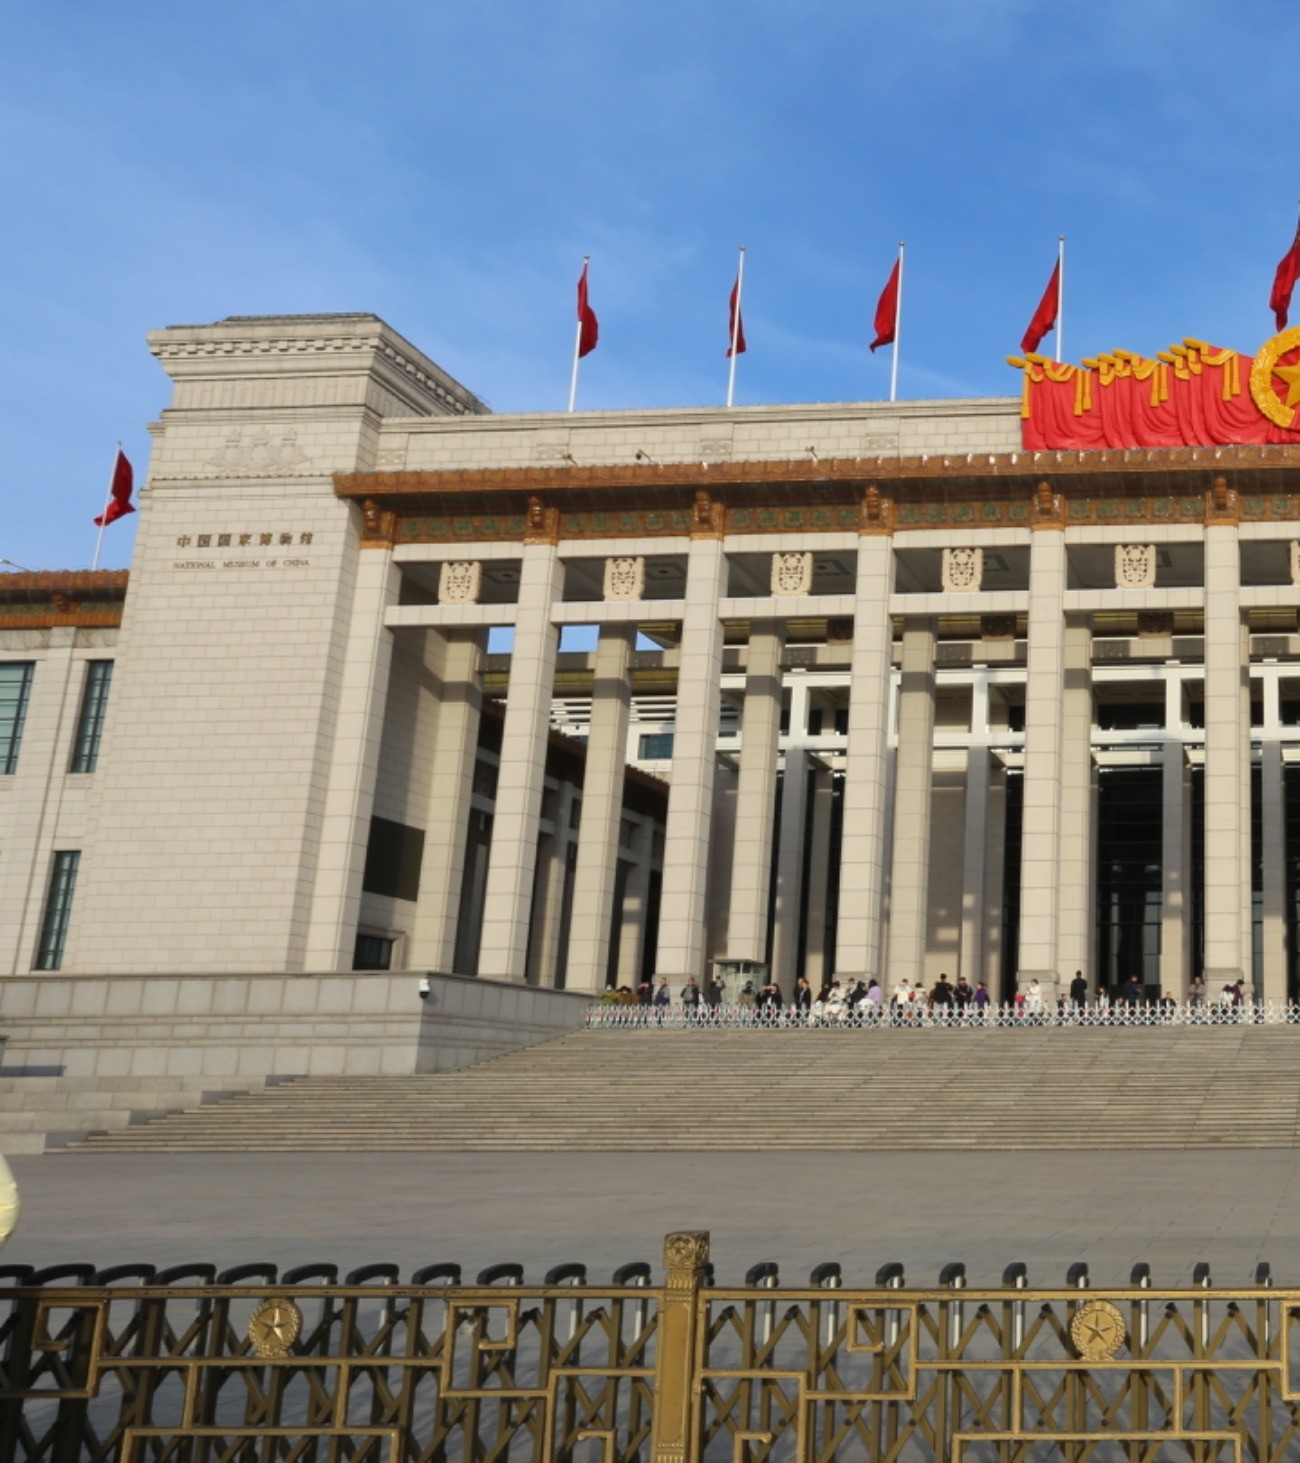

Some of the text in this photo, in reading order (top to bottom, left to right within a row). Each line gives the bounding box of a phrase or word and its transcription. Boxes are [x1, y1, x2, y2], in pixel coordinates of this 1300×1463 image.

[176, 532, 313, 548] 中国国家博物馆
[173, 561, 215, 569] NATIONAL
[265, 560, 278, 568] OF
